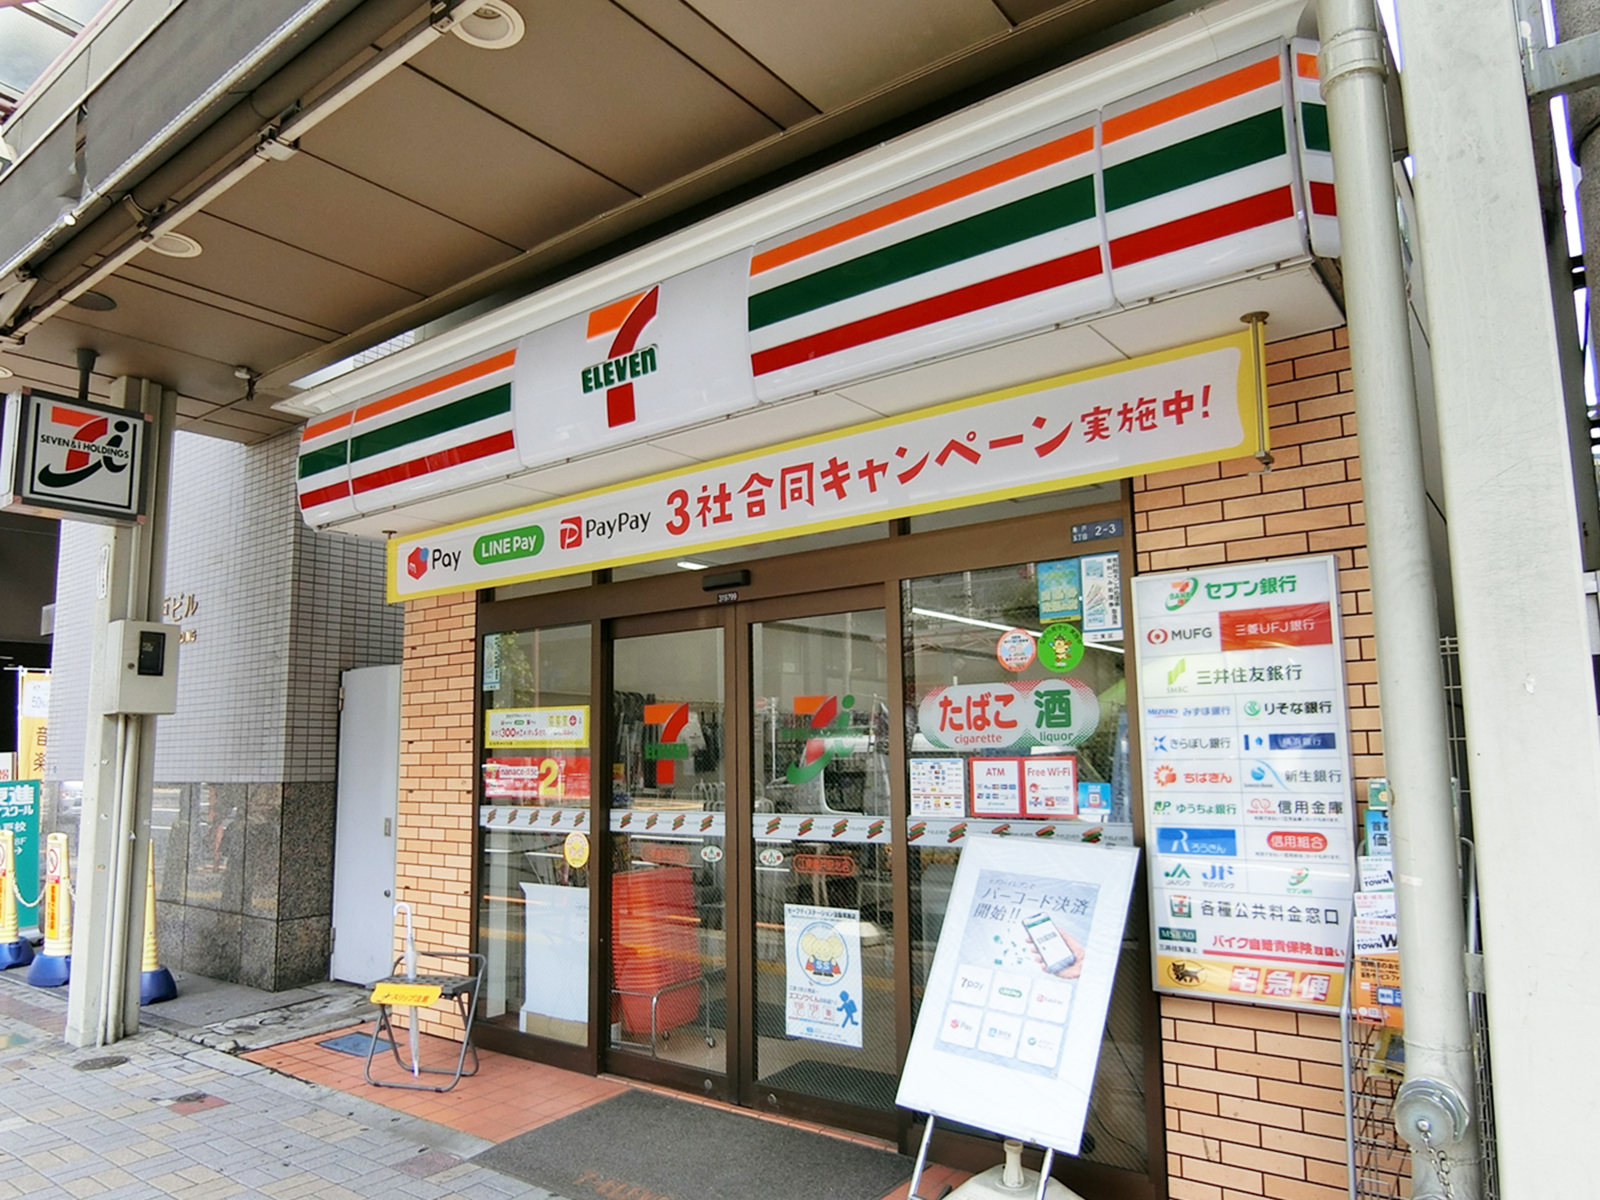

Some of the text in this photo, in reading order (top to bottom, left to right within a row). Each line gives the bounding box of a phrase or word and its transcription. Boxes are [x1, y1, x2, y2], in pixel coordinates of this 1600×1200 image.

[83, 444, 130, 459] HOLDINGS
[585, 511, 651, 540] PayPay
[1094, 523, 1117, 536] 2-3
[481, 534, 537, 558] LINE Pay
[432, 548, 462, 572] Pay
[1205, 575, 1297, 600] セブン銀行
[1171, 627, 1213, 641] MUFG
[1235, 618, 1316, 637] 三菱UFJ銀行
[1196, 664, 1303, 686] 三井住友銀行
[938, 689, 1071, 732] たばこ 酒
[1147, 708, 1179, 716] MIZUHO
[1182, 706, 1231, 716] みずほ銀行
[1264, 701, 1332, 715] りそな銀行
[954, 730, 1074, 745] cigarette liquor
[1170, 736, 1231, 750] きらぼし銀行
[986, 767, 1006, 777] ATM
[1027, 767, 1046, 777] Free
[1284, 769, 1342, 783] 新生銀行
[1176, 803, 1237, 815] ゆうちょ銀行
[1278, 800, 1344, 815] 信用金庫
[1270, 835, 1325, 850] 信用組合
[981, 887, 1090, 916] バーコード決済
[1201, 900, 1340, 926] 各種公共料金窓口
[1161, 928, 1195, 940] MS&AD
[1212, 935, 1345, 957] バイク自賠責保険取扱い
[1357, 942, 1383, 950] TOWN
[1231, 966, 1331, 1001] 宅急便
